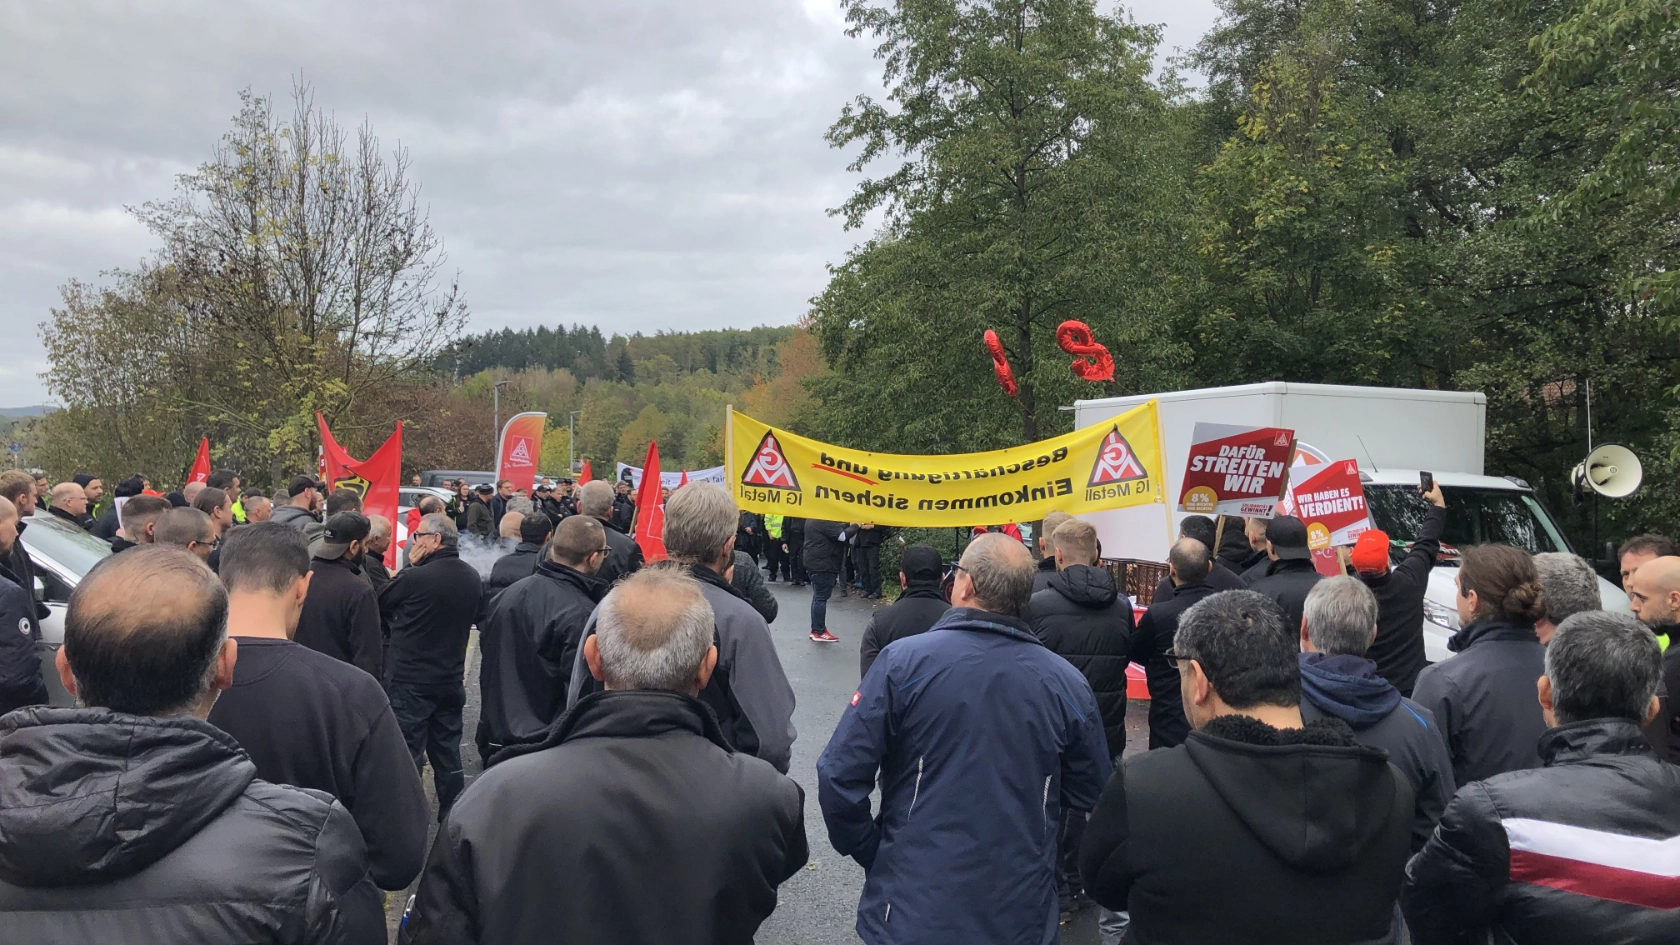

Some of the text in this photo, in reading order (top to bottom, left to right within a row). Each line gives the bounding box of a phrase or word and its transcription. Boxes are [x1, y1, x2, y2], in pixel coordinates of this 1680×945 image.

[1218, 444, 1266, 460] DAFÜR
[1190, 455, 1285, 478] STREITEN
[1223, 474, 1265, 494] WIR
[1297, 487, 1350, 504] WIR HABEN ES
[1299, 496, 1364, 518] VERDIENT!
